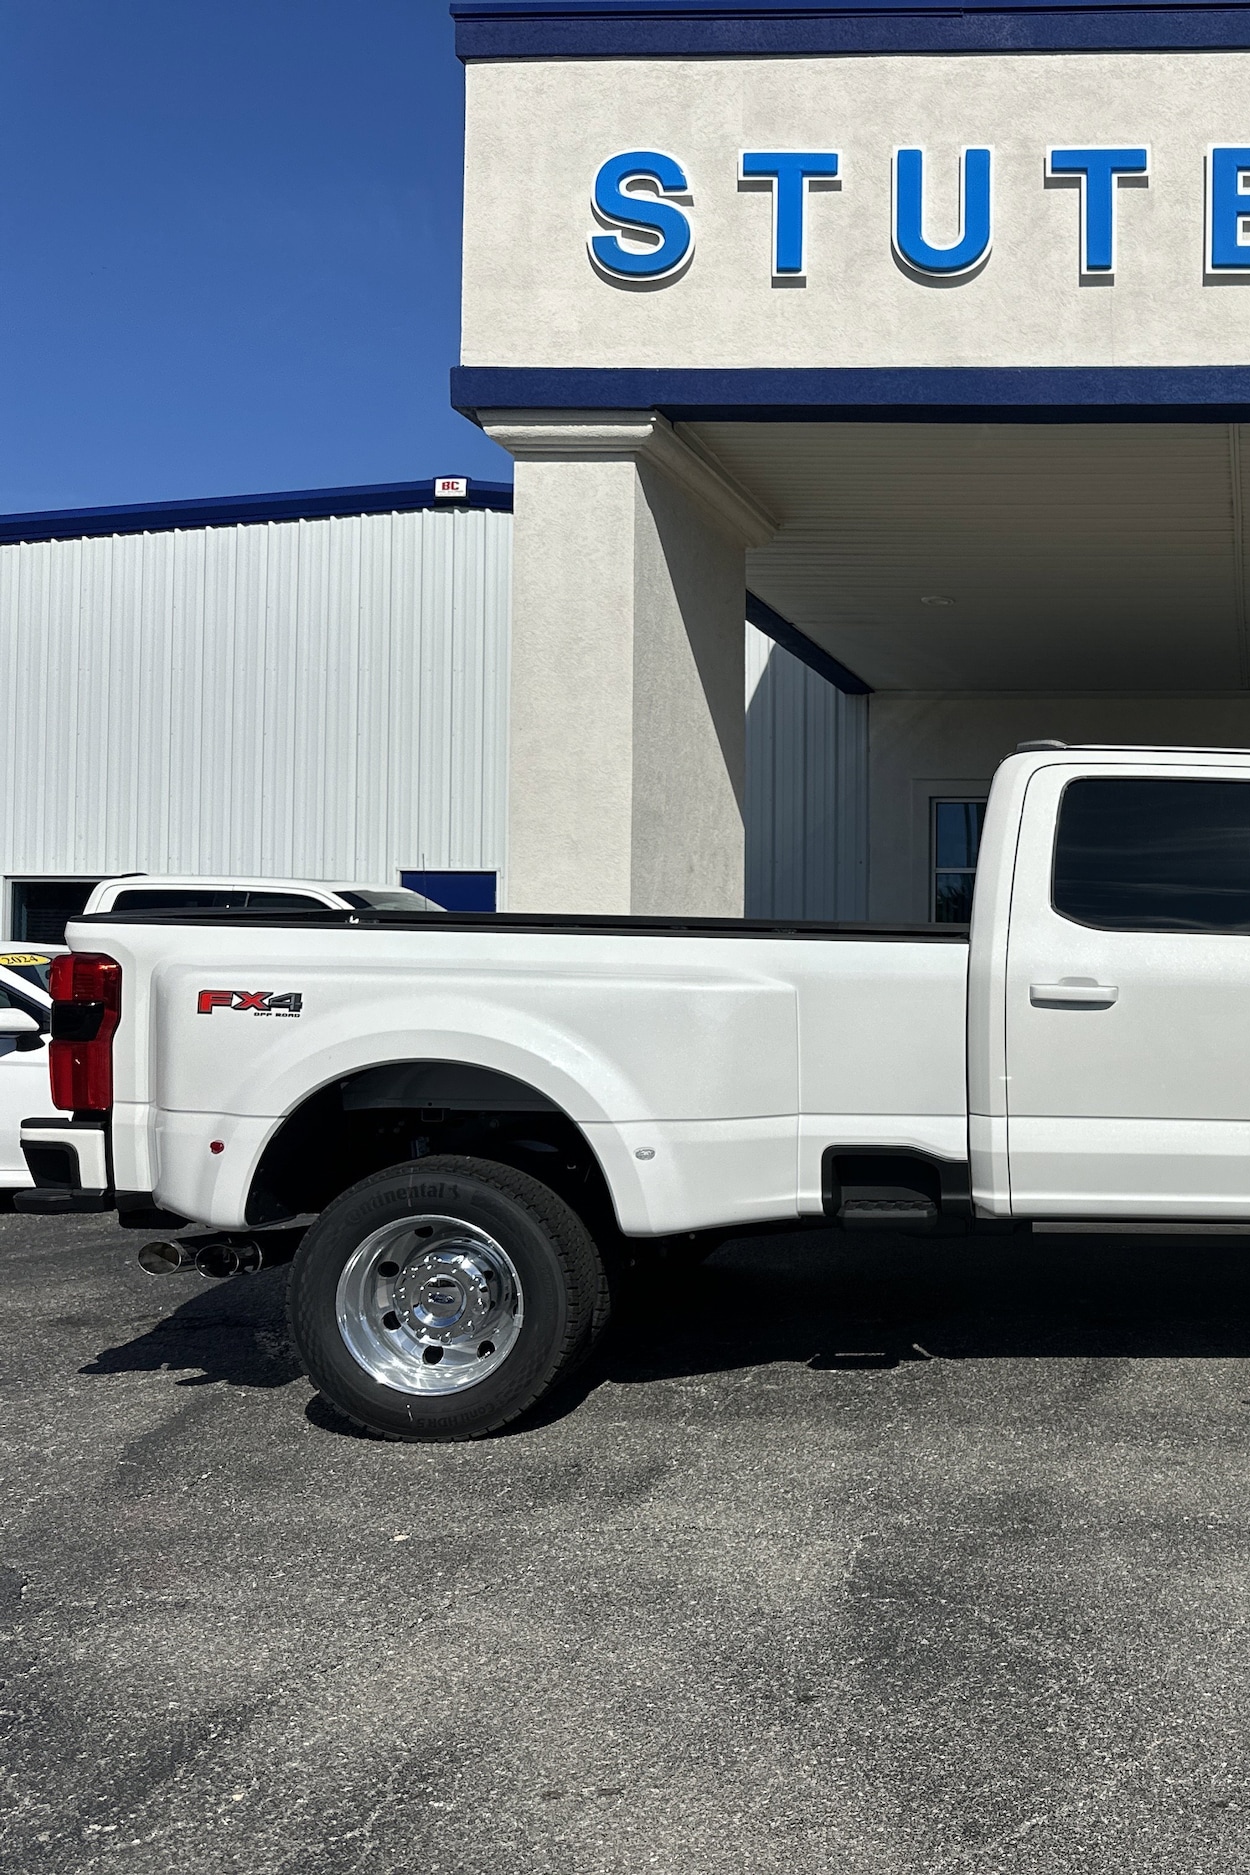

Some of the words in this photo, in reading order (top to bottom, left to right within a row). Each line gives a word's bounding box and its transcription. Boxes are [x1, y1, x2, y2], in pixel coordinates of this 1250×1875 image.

[442, 481, 460, 490] BC
[1, 955, 38, 964] 2024
[197, 990, 302, 1014] FX4
[343, 1182, 445, 1224] Continental
[461, 1402, 496, 1423] Conti
